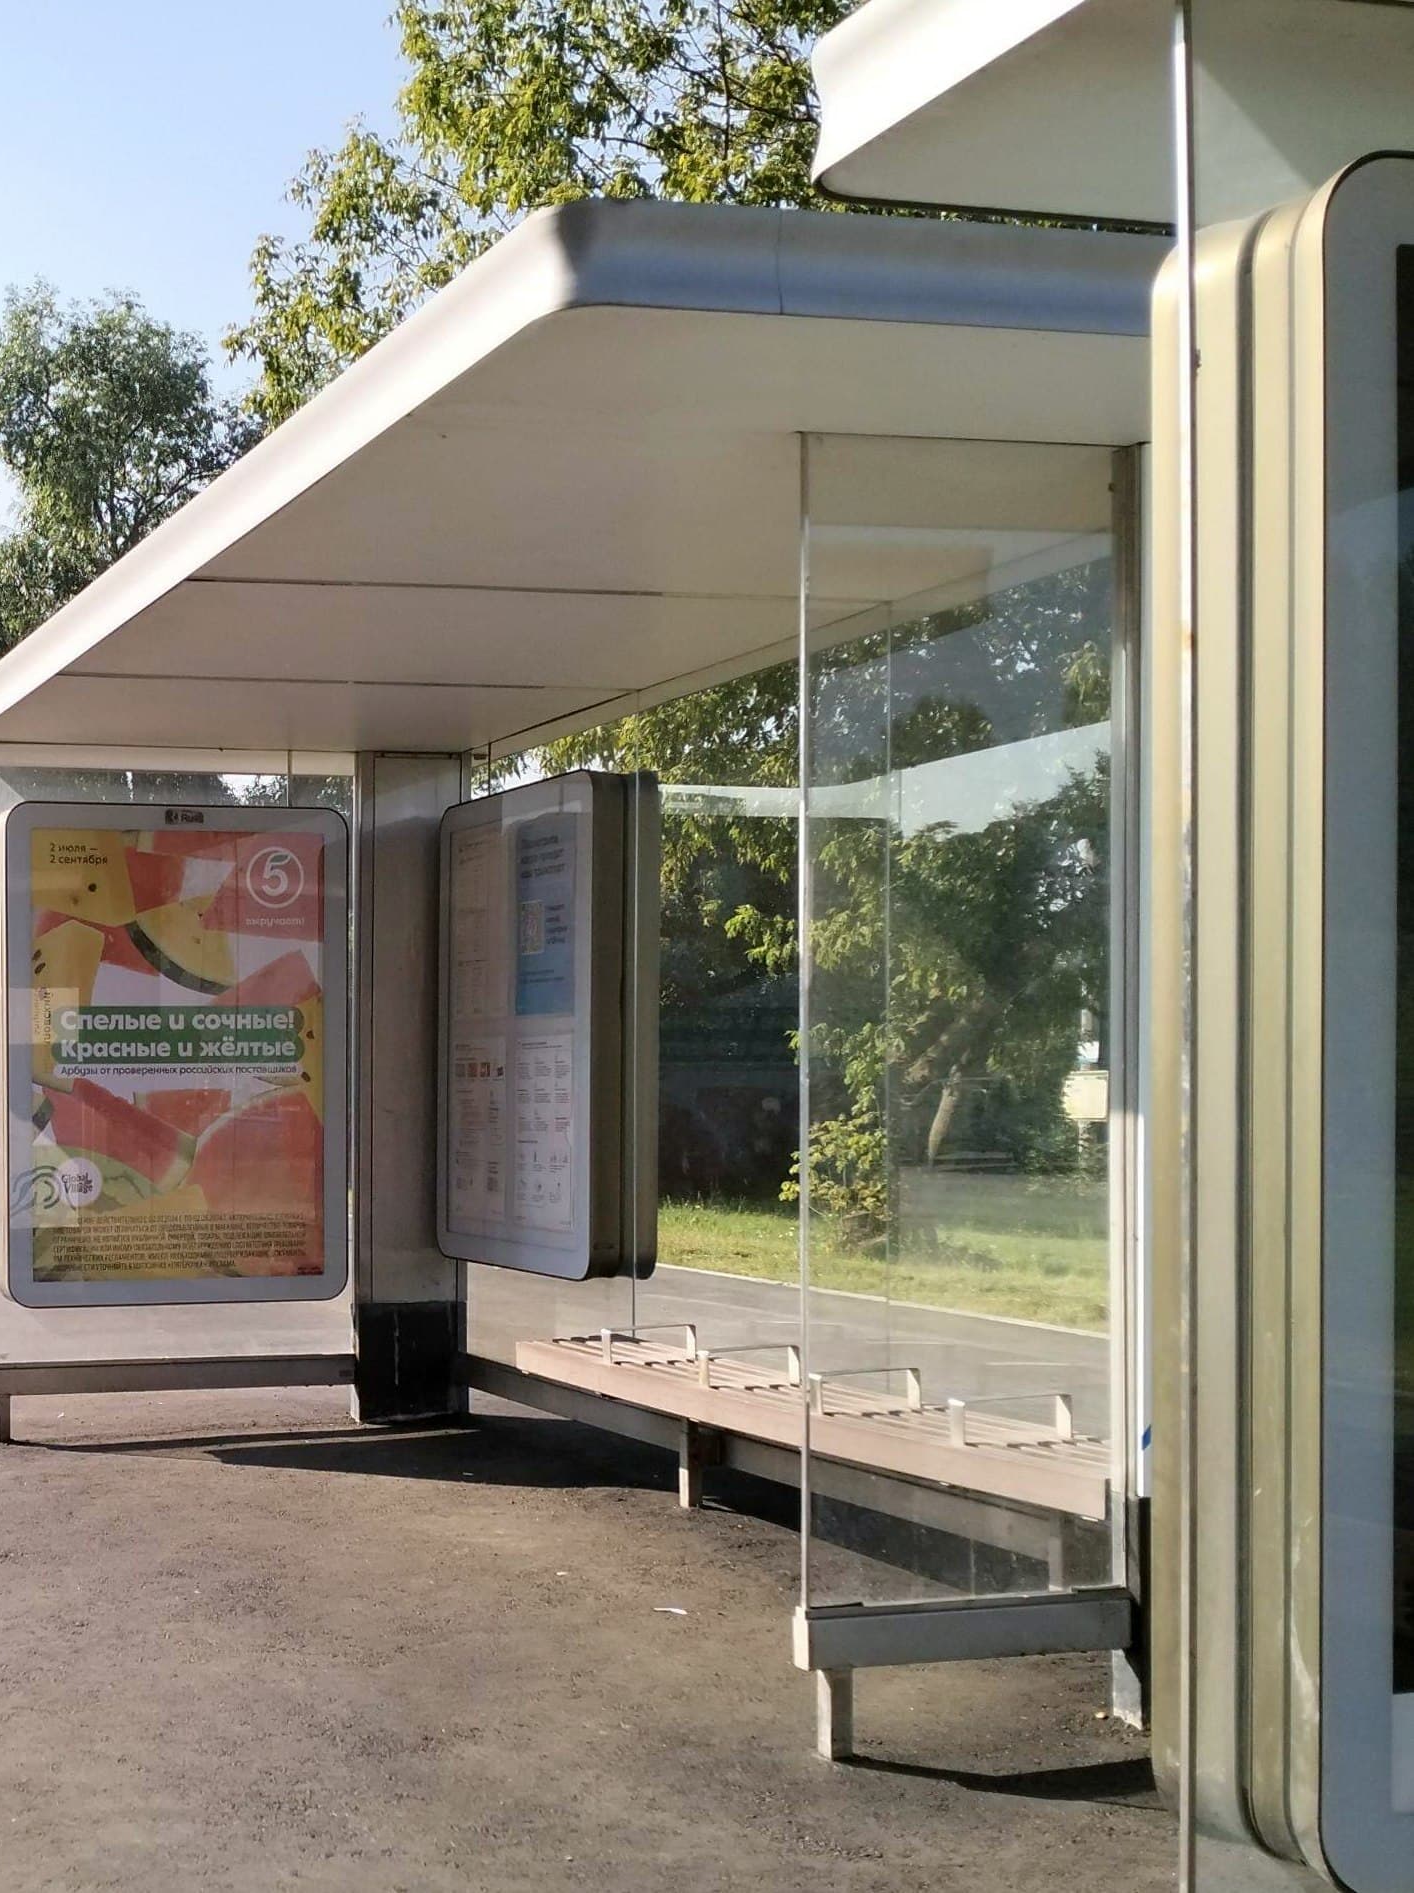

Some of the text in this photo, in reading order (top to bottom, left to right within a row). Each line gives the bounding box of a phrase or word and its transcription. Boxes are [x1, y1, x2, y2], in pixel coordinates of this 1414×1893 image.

[49, 842, 56, 853] 2
[58, 844, 86, 853] июля
[49, 854, 108, 867] 2 сентября
[60, 1010, 162, 1031] Спелые
[168, 1013, 185, 1031] и
[191, 1010, 295, 1031] сочные!
[60, 1035, 297, 1062] Красные и жёлтые
[61, 1064, 297, 1077] Арбузы от проверенных российских поставщиков
[61, 1172, 90, 1184] Global
[64, 1183, 94, 1195] Village
